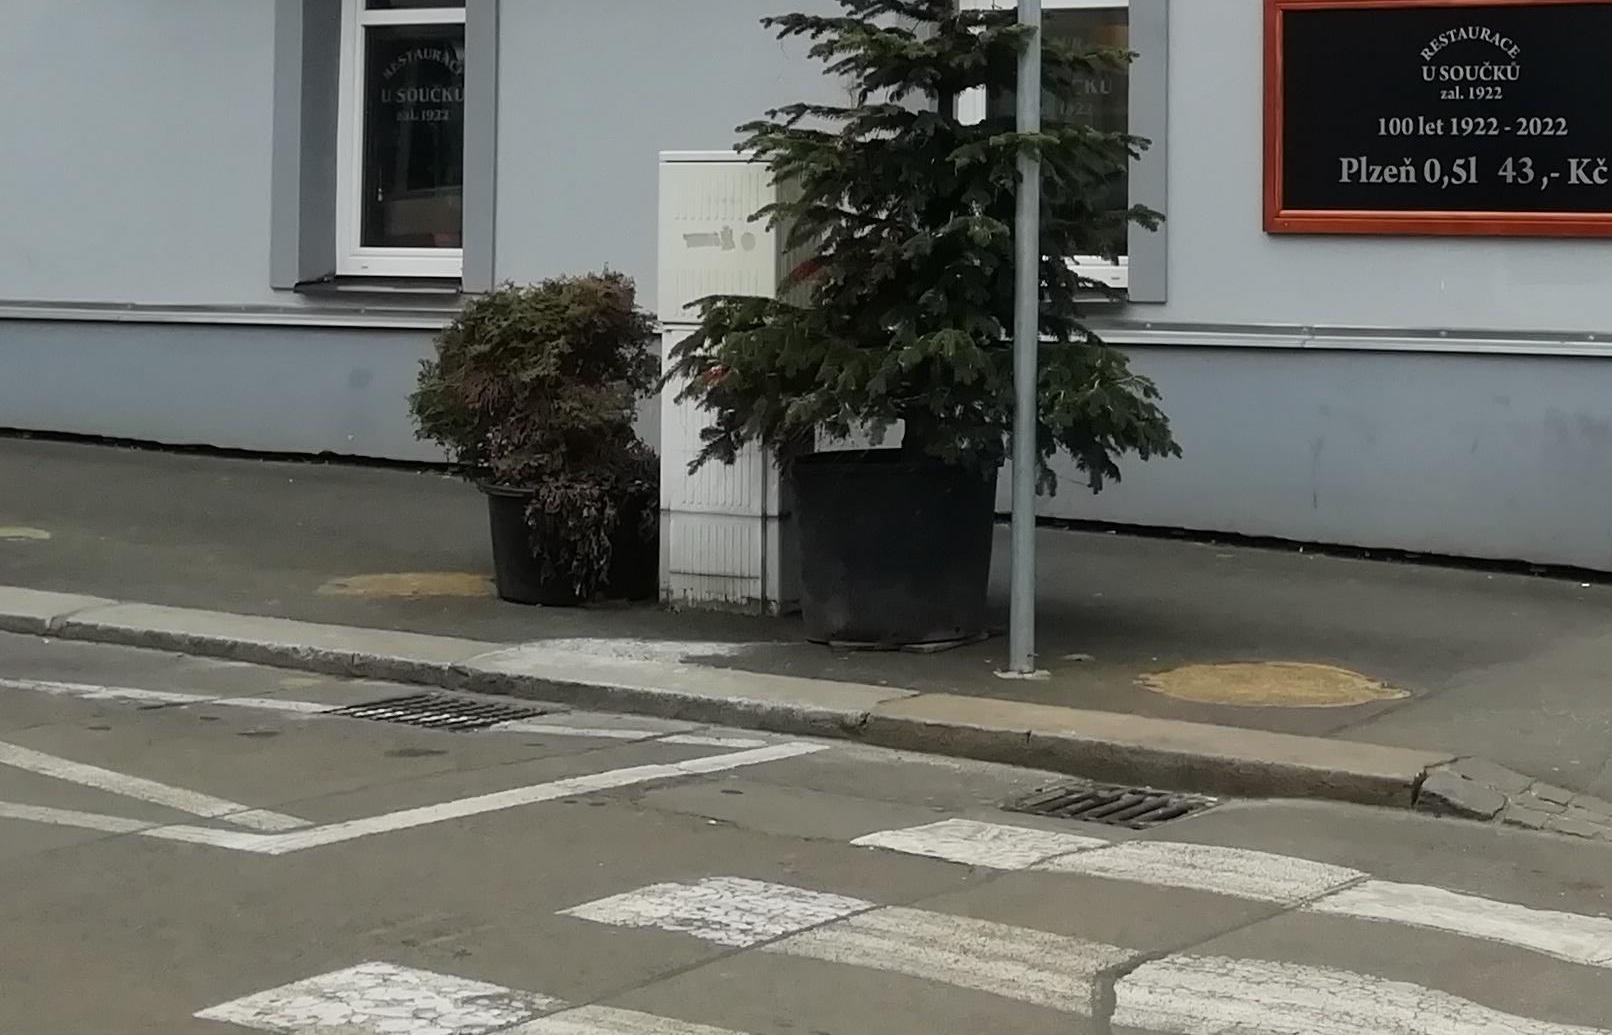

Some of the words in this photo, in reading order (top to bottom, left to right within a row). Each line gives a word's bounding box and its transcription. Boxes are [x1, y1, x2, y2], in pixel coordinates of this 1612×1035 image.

[1420, 26, 1521, 62] RESTAURACE
[1422, 65, 1436, 82] U
[1439, 61, 1521, 82] SOUČKŮ
[1440, 85, 1464, 100] zal.
[1469, 86, 1503, 100] 1922
[1377, 117, 1414, 136] 100
[1417, 115, 1444, 137] let
[1450, 117, 1500, 137] 1922
[1516, 117, 1568, 136] 2022
[1338, 155, 1417, 184] Plzeň
[1423, 155, 1479, 190] 0,5l
[1567, 156, 1609, 186] Kč
